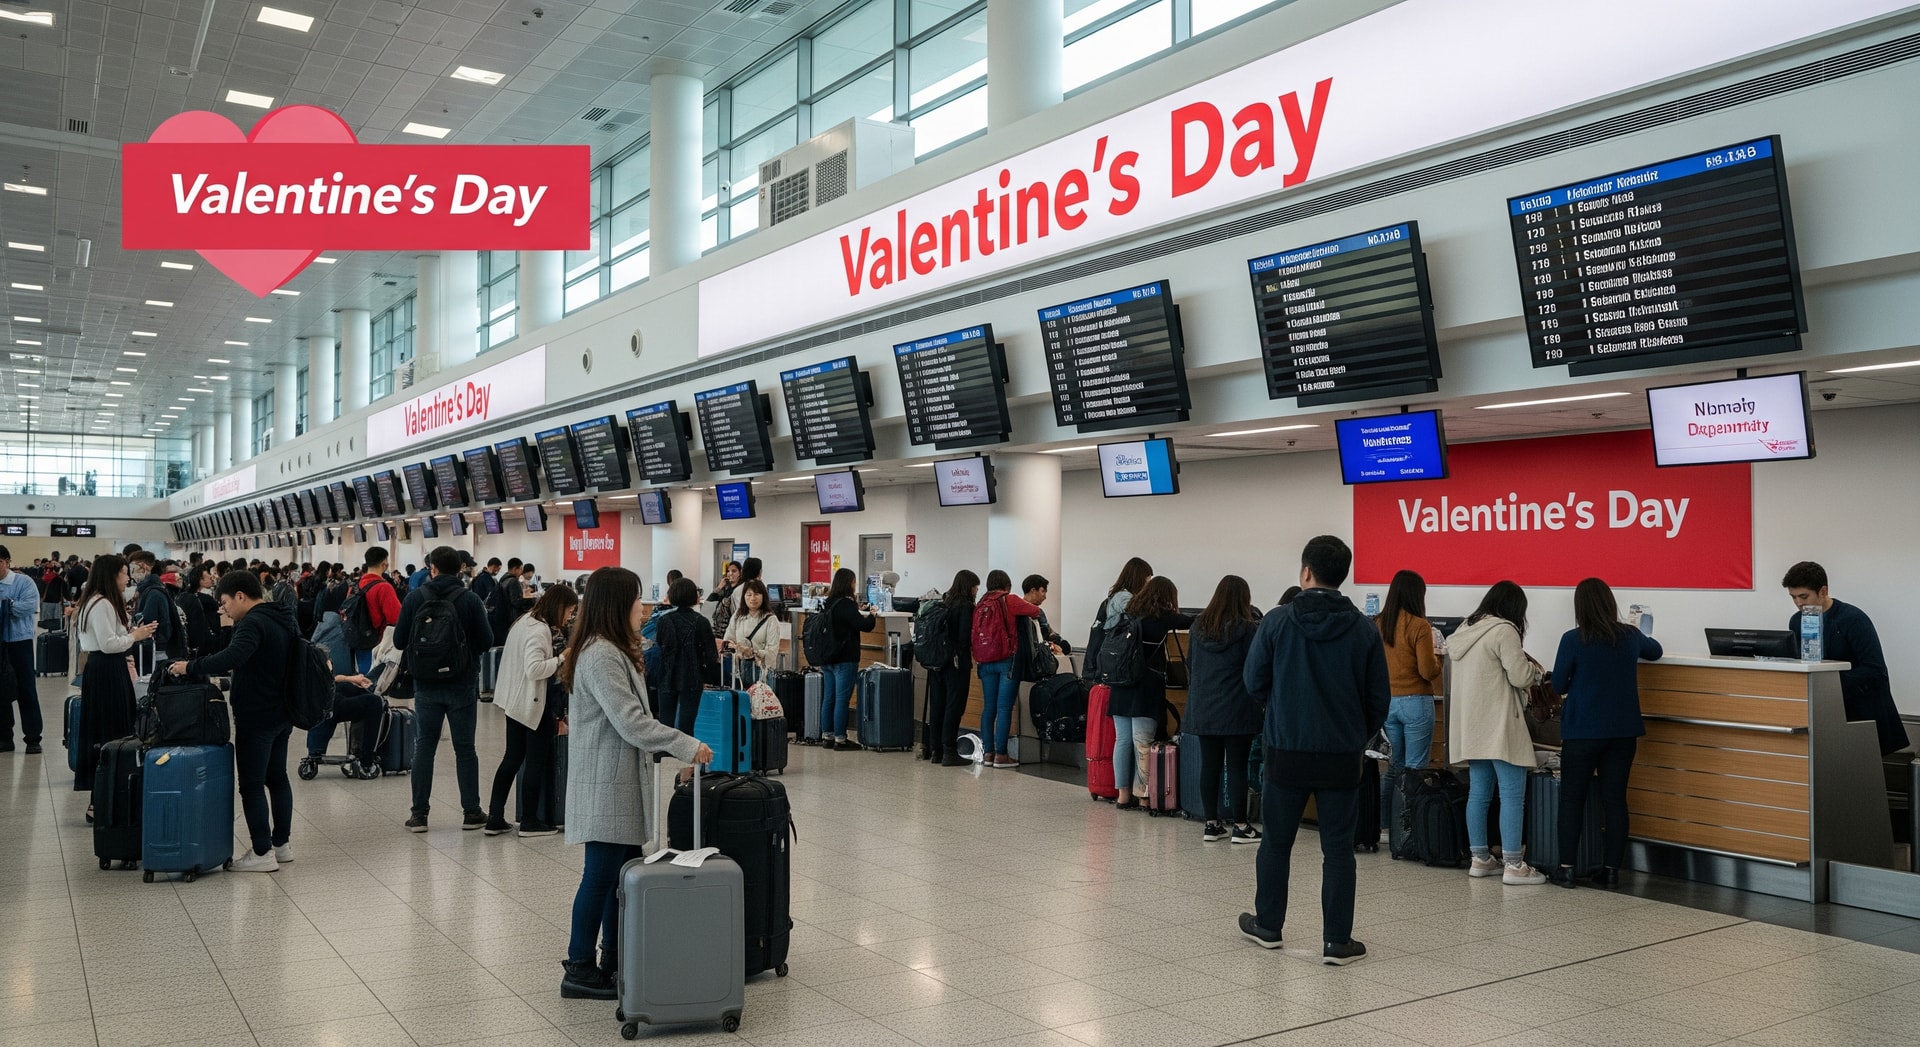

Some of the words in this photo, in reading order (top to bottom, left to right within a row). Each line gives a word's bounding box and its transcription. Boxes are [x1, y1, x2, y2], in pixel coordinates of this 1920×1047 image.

[839, 135, 1141, 297] Valentine's
[1170, 77, 1333, 199] Day
[404, 384, 463, 437] Valentine's
[466, 381, 491, 421] Day
[1398, 491, 1595, 533] Valentine's
[1608, 489, 1690, 539] Day
